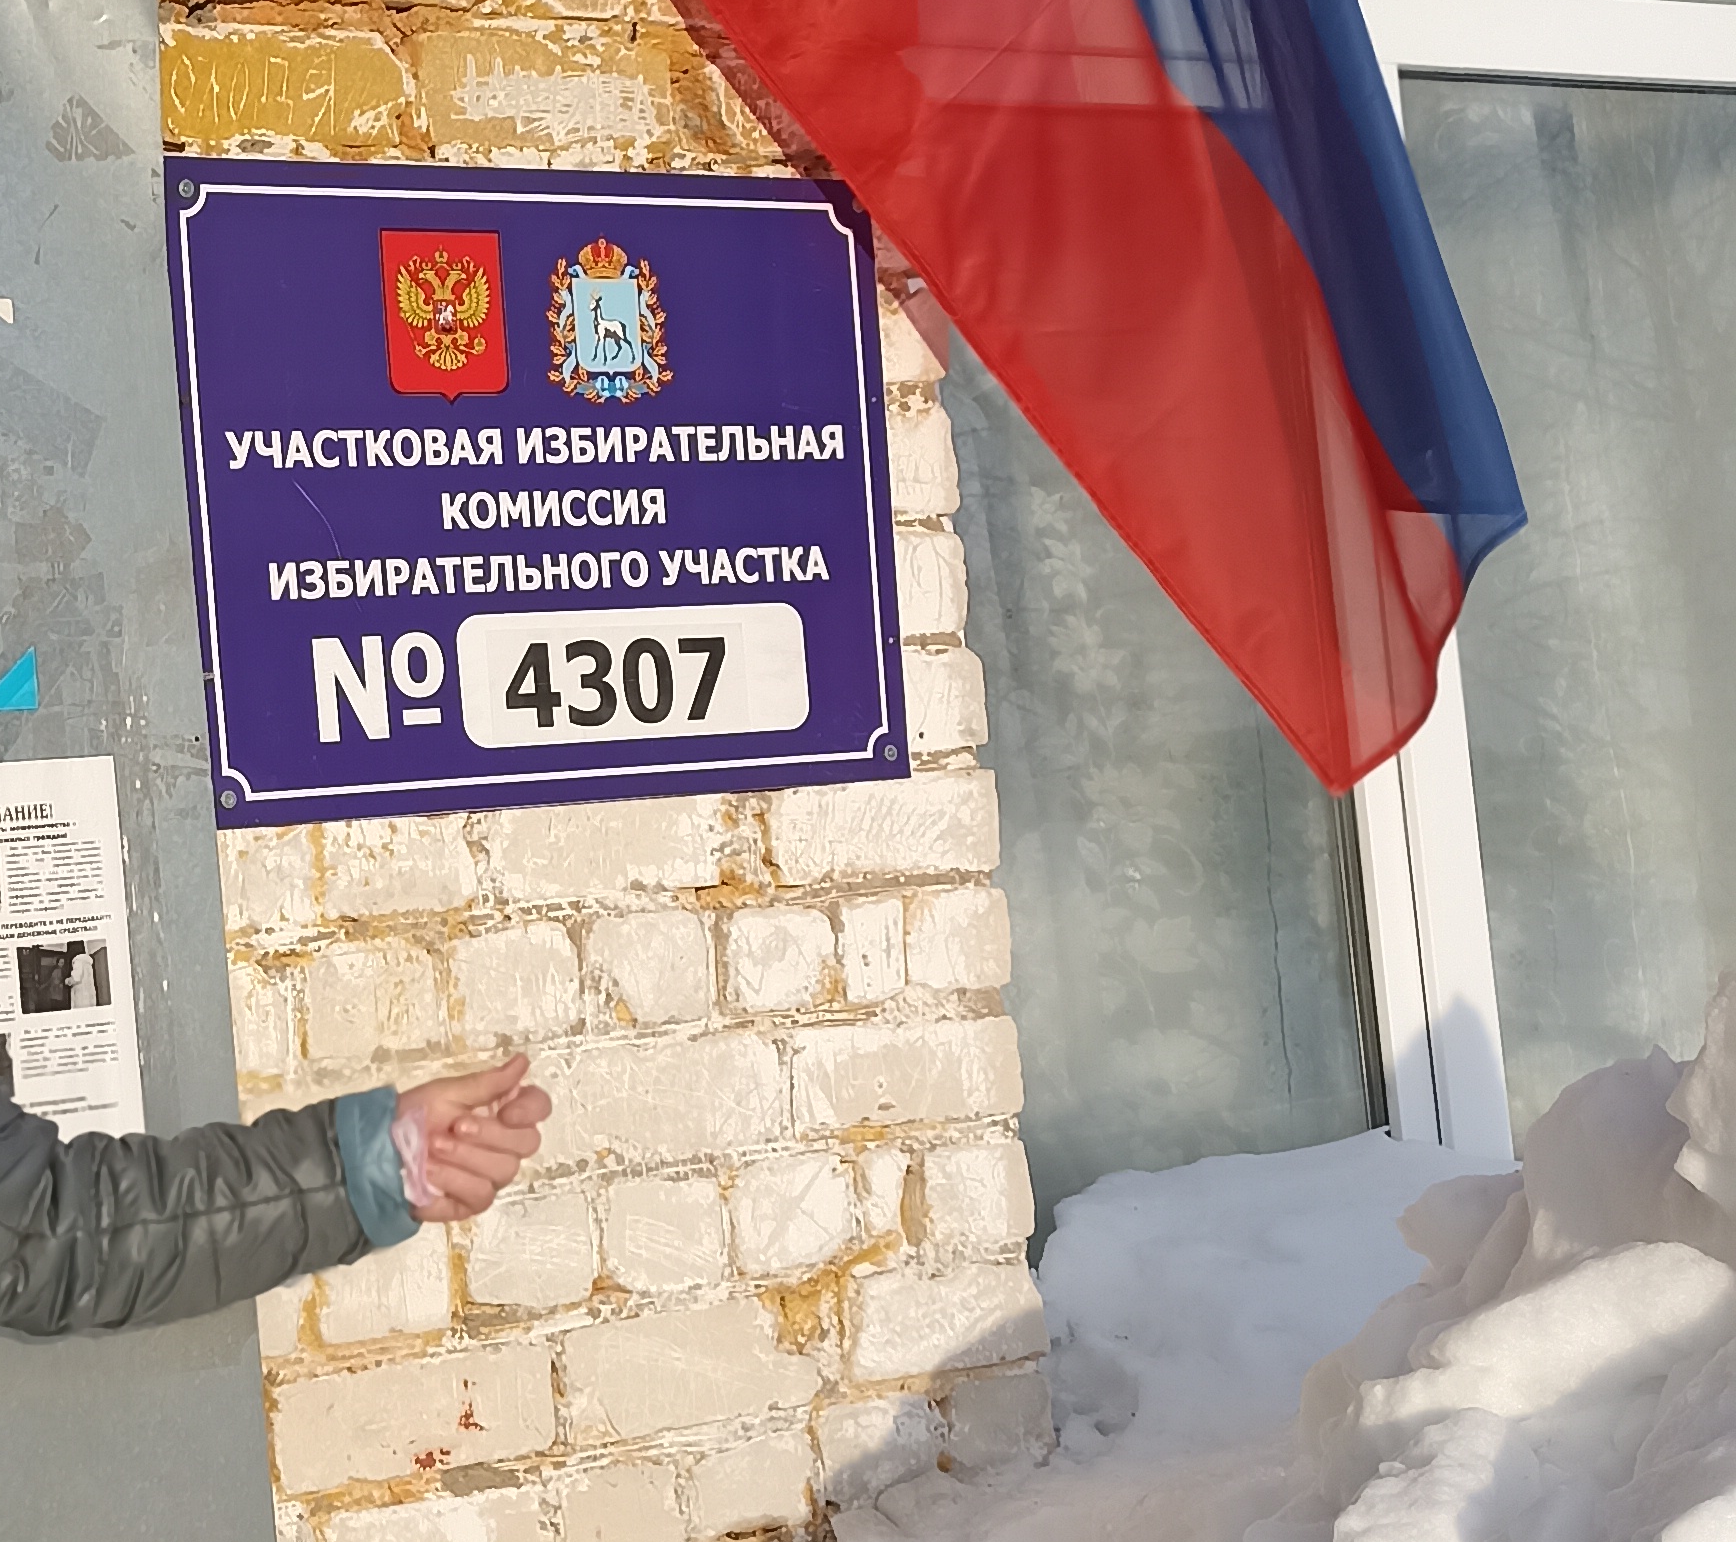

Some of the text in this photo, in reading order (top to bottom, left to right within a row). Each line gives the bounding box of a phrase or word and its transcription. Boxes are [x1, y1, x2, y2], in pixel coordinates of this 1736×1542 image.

[225, 424, 845, 470] УЧАСТКОВАЯ ИЗБИРАТЕЛЬНАЯ
[441, 488, 667, 530] КОМИССИЯ
[268, 546, 829, 602] ИЗБИРАТЕЛЬНОГО УЧАСТКА
[504, 636, 727, 730] 4307
